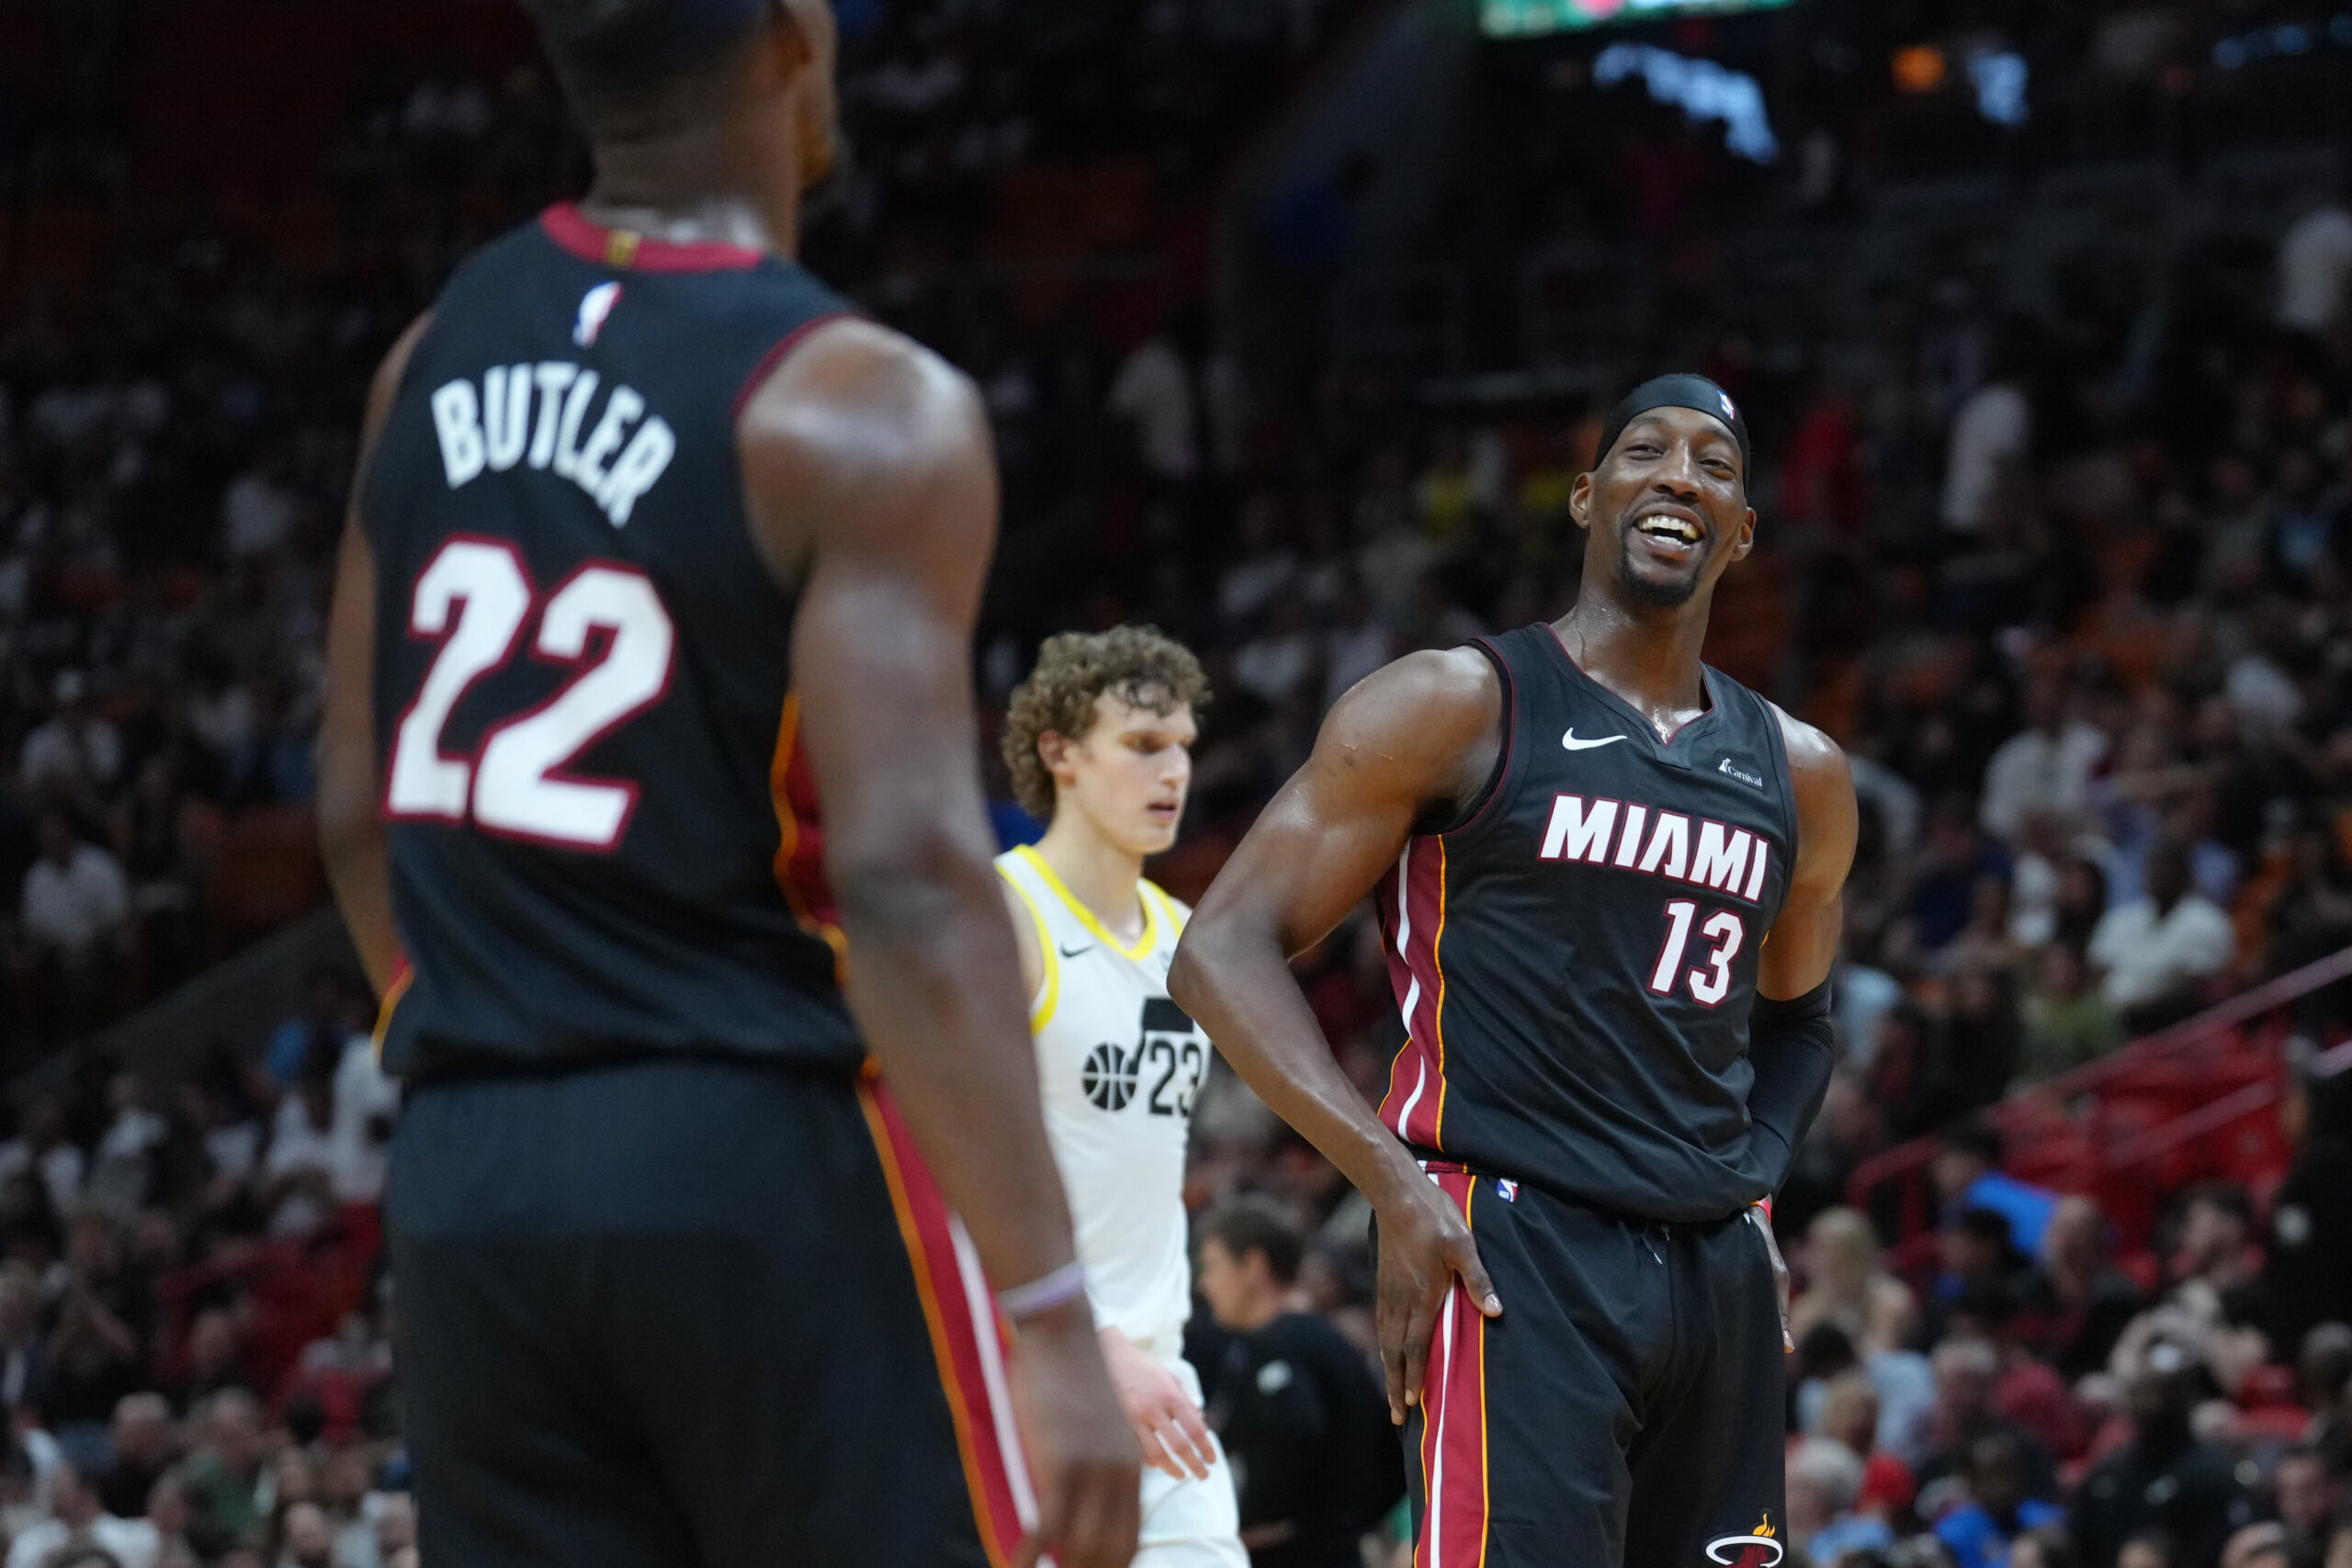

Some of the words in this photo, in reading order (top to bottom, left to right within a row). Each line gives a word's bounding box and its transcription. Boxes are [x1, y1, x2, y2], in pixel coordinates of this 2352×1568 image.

[432, 362, 676, 526] BUTLER
[384, 536, 677, 849] 22
[1727, 765, 1763, 788] Carnival
[1538, 794, 1770, 904] MIAMI
[1649, 899, 1745, 1008] 13
[1148, 1038, 1203, 1118] 23
